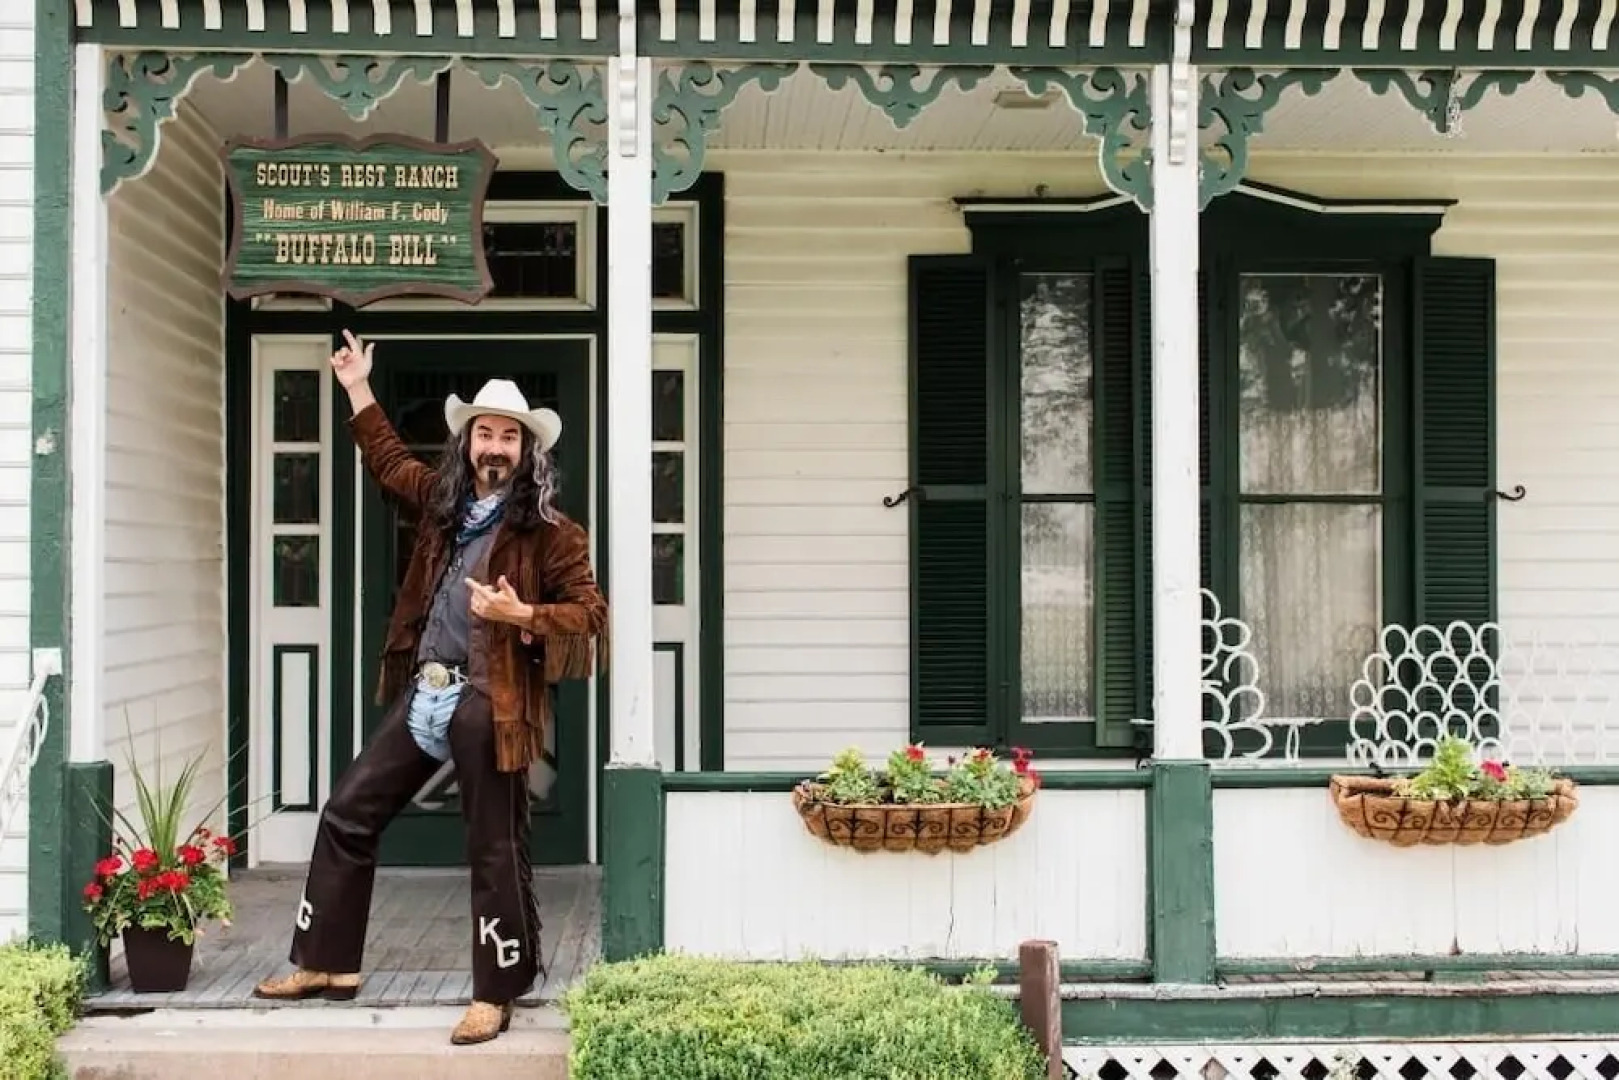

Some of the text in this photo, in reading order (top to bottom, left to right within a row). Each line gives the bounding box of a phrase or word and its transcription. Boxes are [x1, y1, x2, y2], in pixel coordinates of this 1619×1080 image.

[256, 162, 459, 189] SCOUT'S REST RANCH
[263, 199, 449, 225] Home of William F. Cody
[297, 892, 314, 931] G
[478, 916, 521, 968] KG
